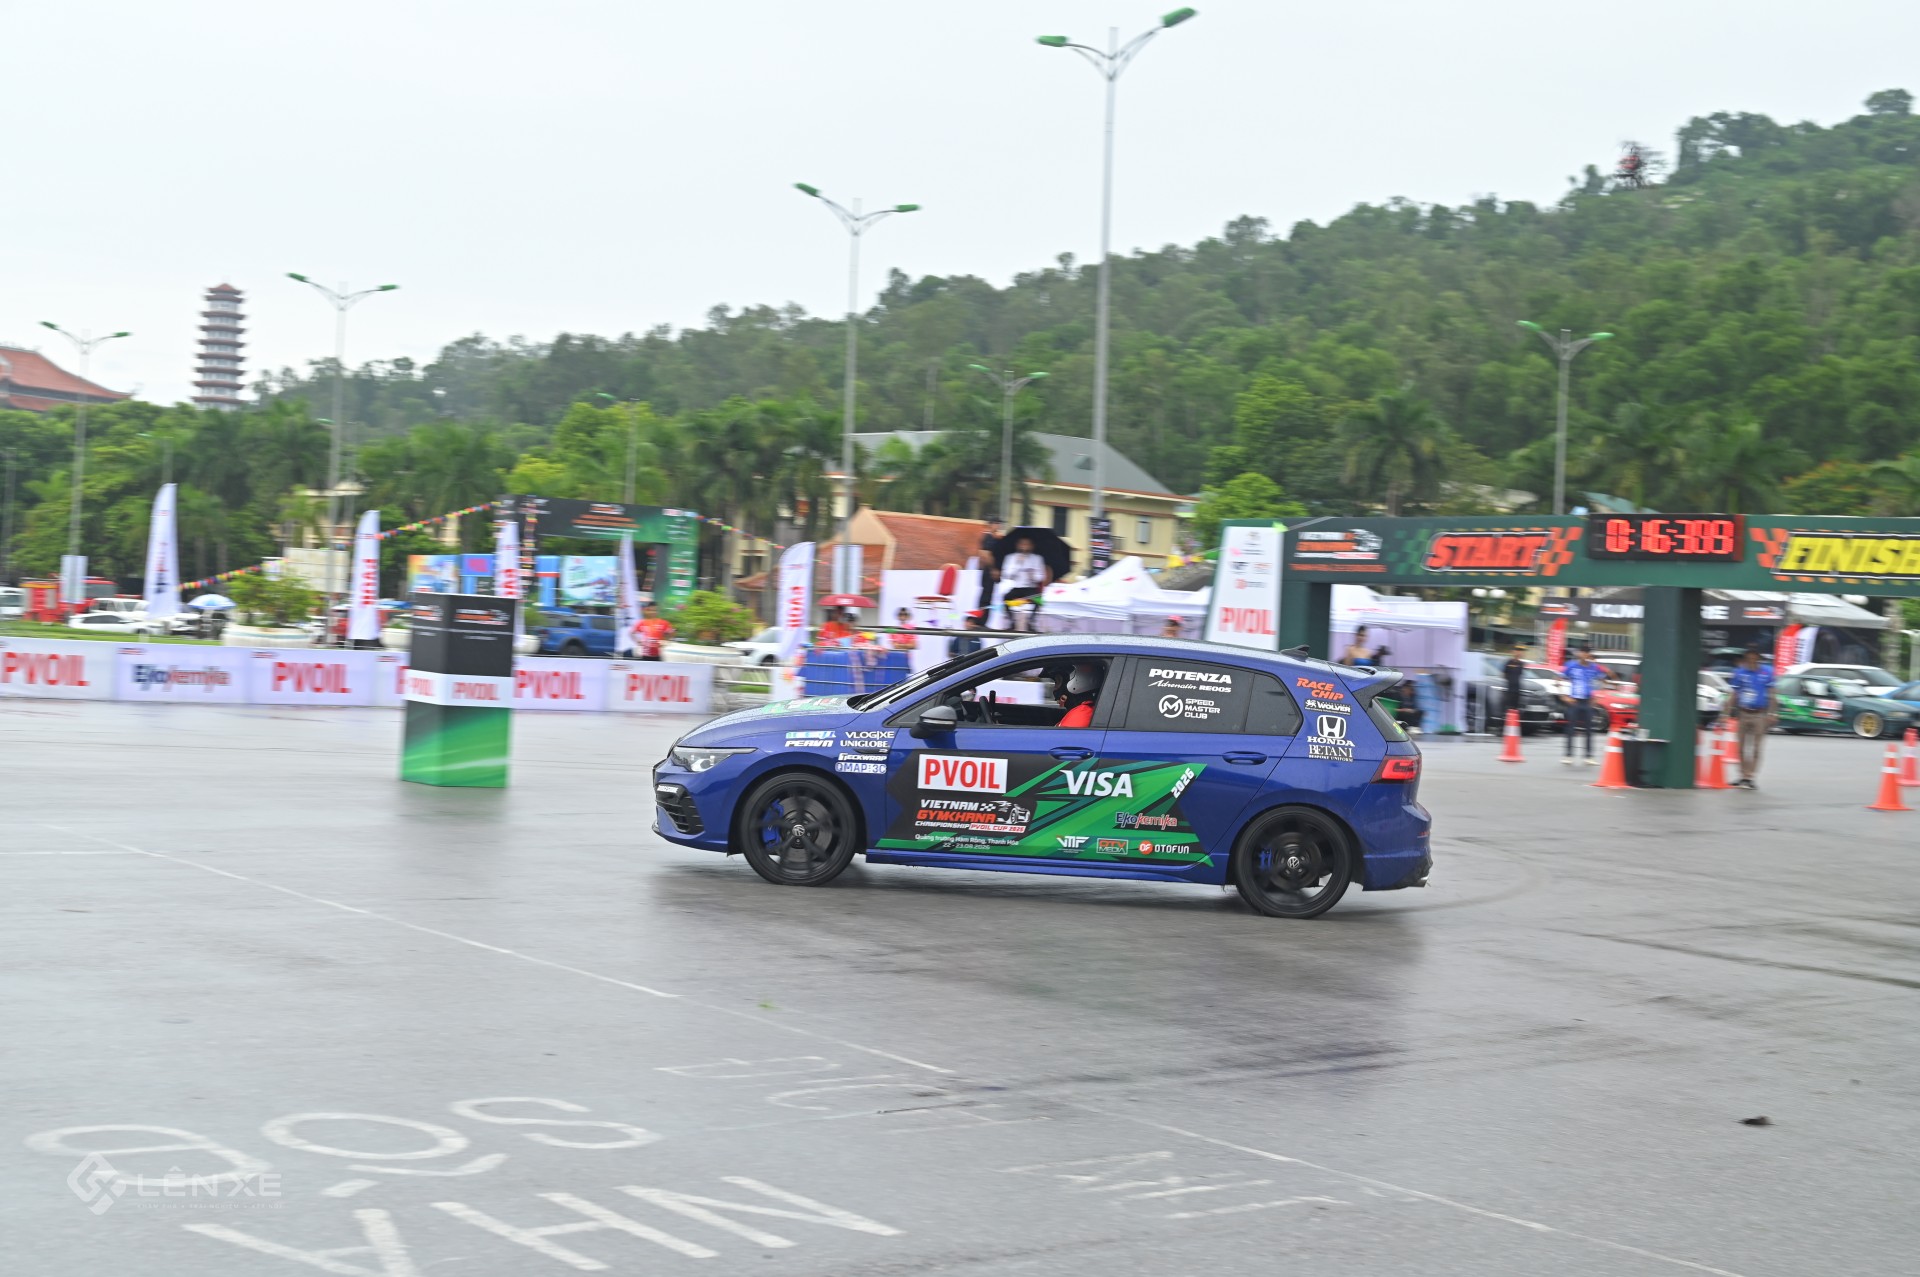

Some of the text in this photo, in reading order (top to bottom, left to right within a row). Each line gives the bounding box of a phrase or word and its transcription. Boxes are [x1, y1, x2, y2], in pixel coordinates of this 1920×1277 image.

[1427, 535, 1546, 569] START
[1218, 606, 1277, 636] PVOIL
[1, 651, 90, 687] PVOIL
[272, 661, 352, 694] PVOIL
[1148, 668, 1232, 685] POTENZA
[514, 669, 585, 700] PVOIL
[625, 673, 693, 703] PVOIL
[1148, 680, 1197, 690] Adrenalin
[1297, 677, 1335, 691] RACE
[1185, 698, 1215, 706] SPEED
[1311, 689, 1345, 701] CHIP
[1184, 705, 1221, 714] MASTER
[1317, 701, 1351, 713] WOLVER
[1307, 736, 1356, 747] HONDA
[1309, 745, 1353, 758] BETANI
[924, 759, 1000, 790] PVOIL
[1059, 769, 1134, 798] VISA
[1170, 767, 1195, 799] 2026
[920, 799, 980, 812] VIETNAM
[916, 809, 997, 824] GYMKHANA
[914, 821, 970, 830] CHAMPIONSHIP
[1154, 845, 1190, 854] OTOFUN
